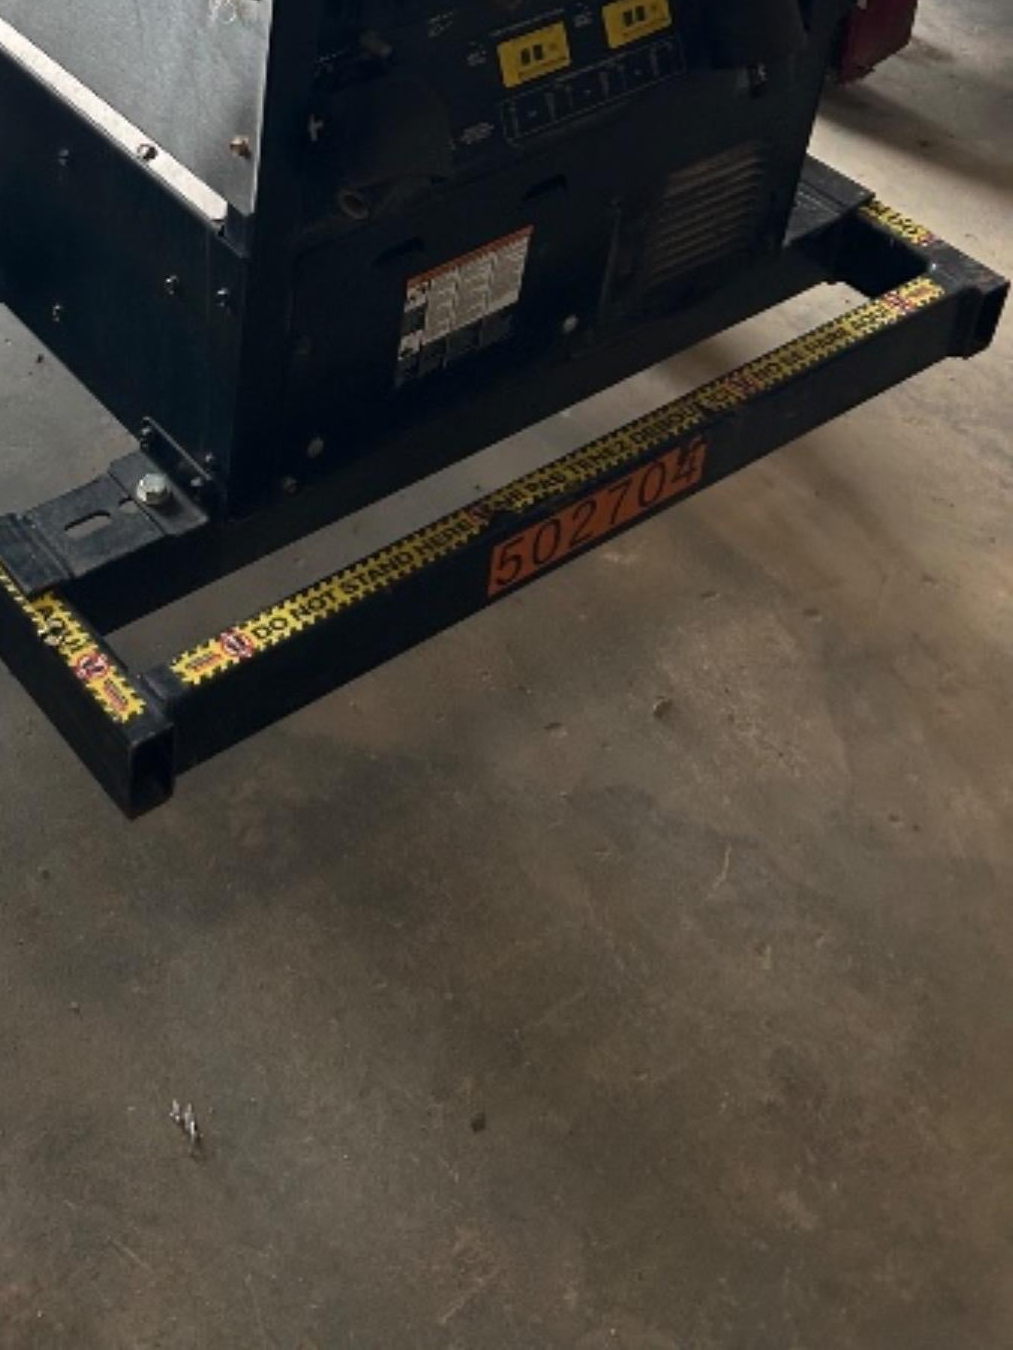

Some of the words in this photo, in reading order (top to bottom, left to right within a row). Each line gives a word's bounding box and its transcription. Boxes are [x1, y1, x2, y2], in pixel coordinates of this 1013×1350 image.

[496, 436, 707, 587] 502704
[251, 616, 289, 641] DO
[290, 590, 338, 622] NOT
[341, 548, 416, 595] STAND
